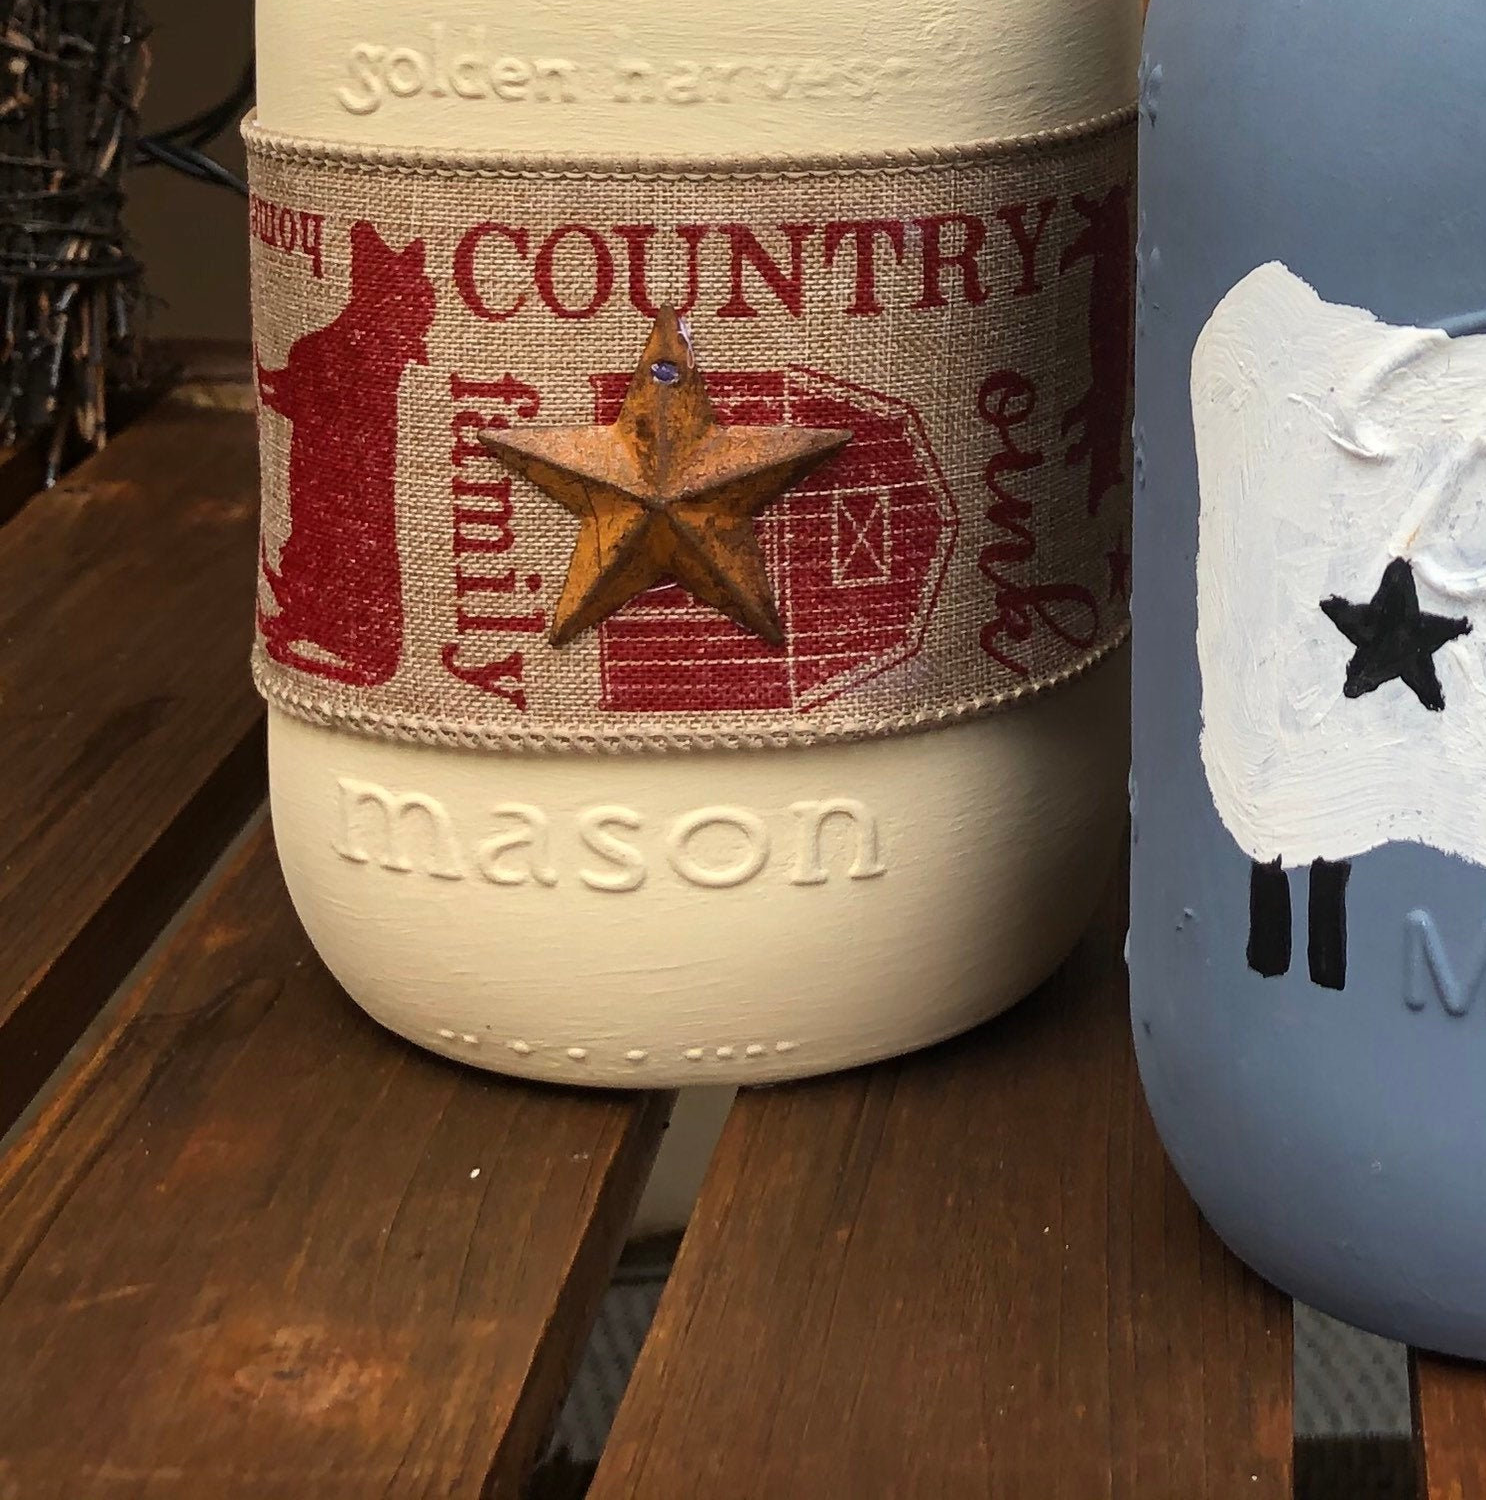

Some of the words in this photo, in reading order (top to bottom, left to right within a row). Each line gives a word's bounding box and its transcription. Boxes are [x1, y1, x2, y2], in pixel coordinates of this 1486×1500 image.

[452, 201, 1056, 323] COUNTRY
[977, 370, 1098, 677] oink
[331, 777, 887, 893] mason
